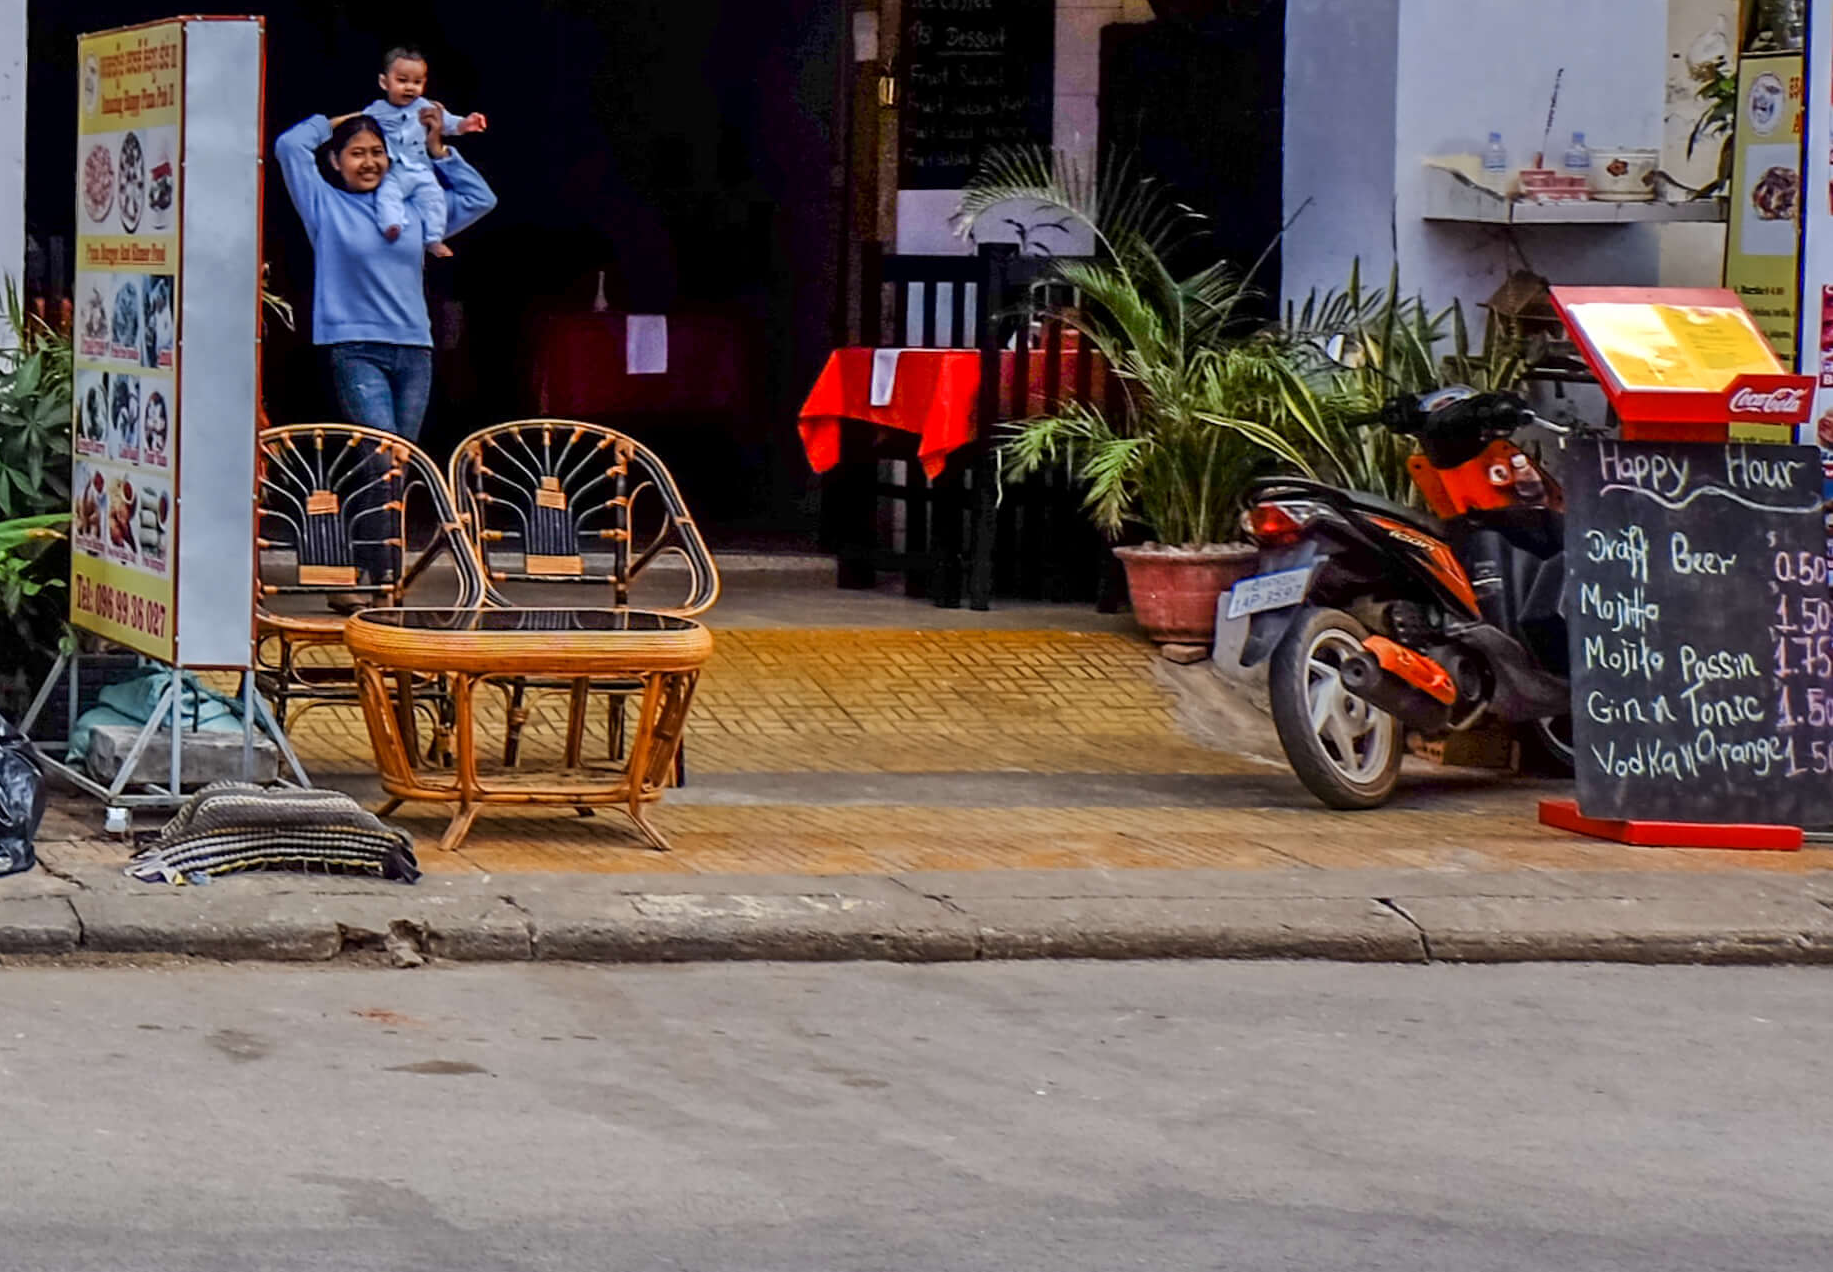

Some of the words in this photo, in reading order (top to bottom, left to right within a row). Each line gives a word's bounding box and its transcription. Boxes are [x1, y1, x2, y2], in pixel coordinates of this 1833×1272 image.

[1598, 440, 1690, 498] Happy
[1724, 443, 1807, 490] Hour
[1671, 531, 1737, 576] Beer
[95, 581, 114, 620] 096
[116, 590, 128, 625] 99
[146, 600, 167, 638] 027
[1587, 690, 1649, 724] Gin
[1679, 680, 1765, 728] Tonic
[1696, 728, 1782, 776] Orange
